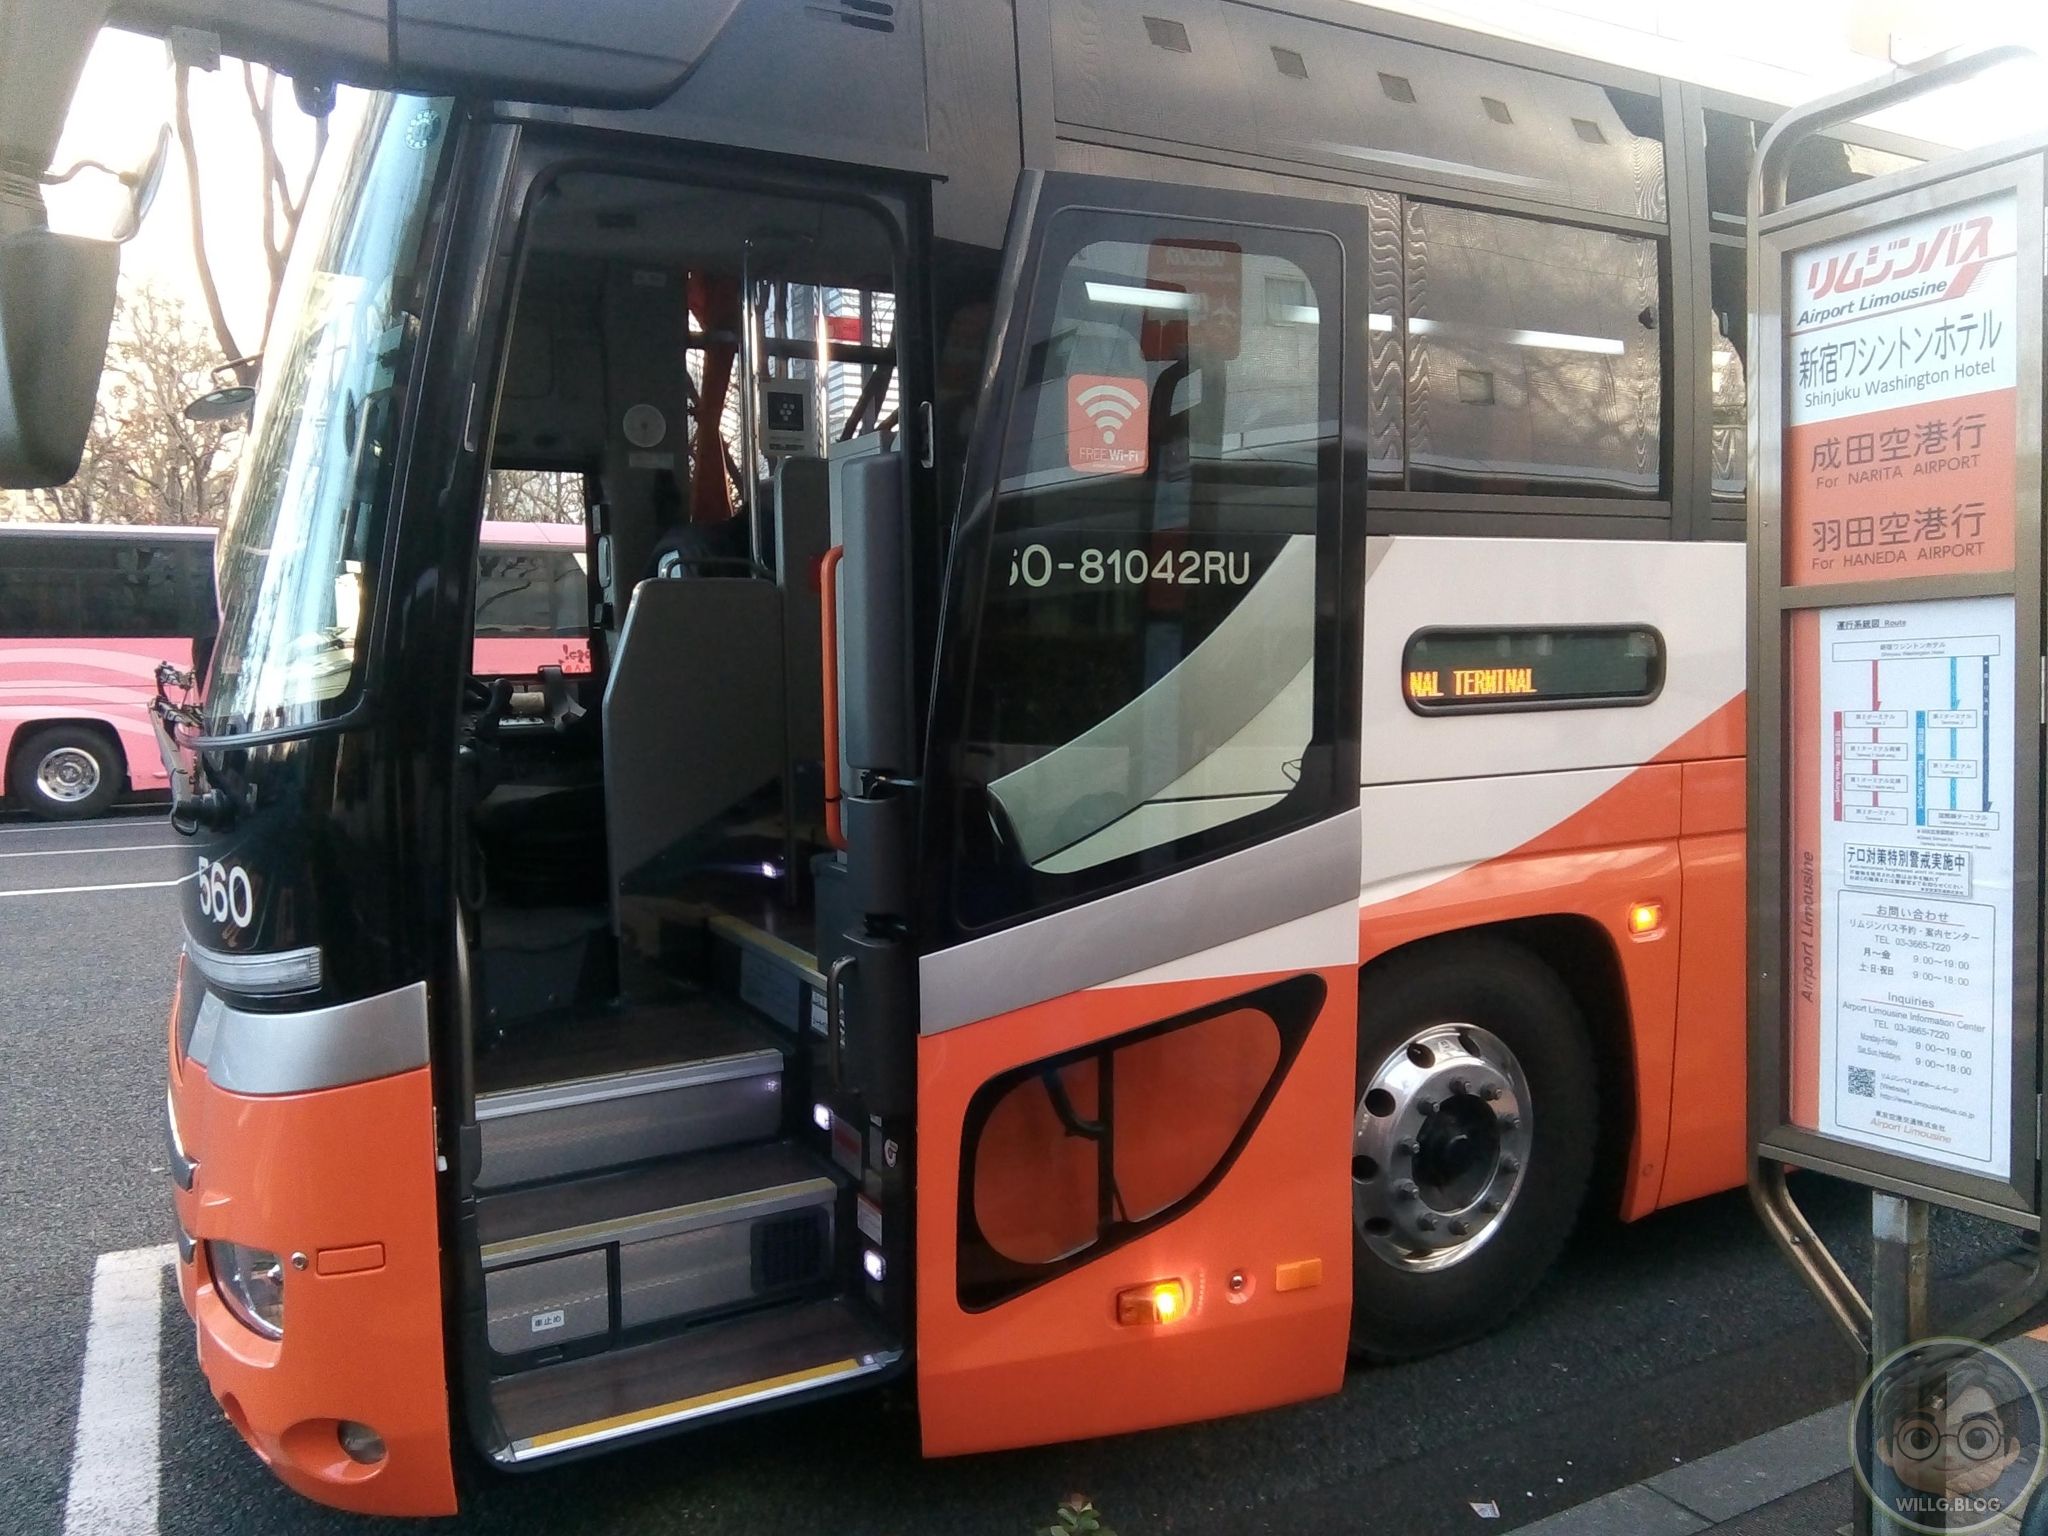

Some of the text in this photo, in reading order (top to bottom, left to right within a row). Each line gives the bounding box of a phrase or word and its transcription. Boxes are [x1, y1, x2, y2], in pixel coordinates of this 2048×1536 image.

[1807, 215, 1993, 300] リムジンバス
[1797, 279, 1947, 326] Airport Limousine
[1799, 309, 2002, 389] 新宿ワシントンホテル
[1805, 357, 1995, 408] Shinjuku Washington Hotel
[1080, 447, 1139, 463] FREE Wi-Fi
[1811, 413, 1986, 473] 成田空港行
[1816, 454, 1980, 489] For NARITA AIRPORT
[1812, 502, 1986, 552] 羽田空港行
[1812, 541, 1984, 570] For HANEDA AIRPORT
[1884, 619, 1907, 628] Route
[1409, 668, 1537, 697] NAL TERMINAL
[1847, 847, 1965, 871] テロ対策特別警戒実施中
[199, 856, 252, 928] 560
[1801, 851, 1816, 1002] Airport Limousine
[1877, 904, 1949, 922] お問い合わせ
[1875, 935, 1951, 952] TEL 03-3665-7220
[1888, 992, 1935, 1008] Inquiries
[1843, 1001, 1986, 1033] Airport Limousine Information Center
[1874, 1019, 1950, 1040] TEL 03-3665-7220
[1871, 1117, 1952, 1143] Airport Limousine
